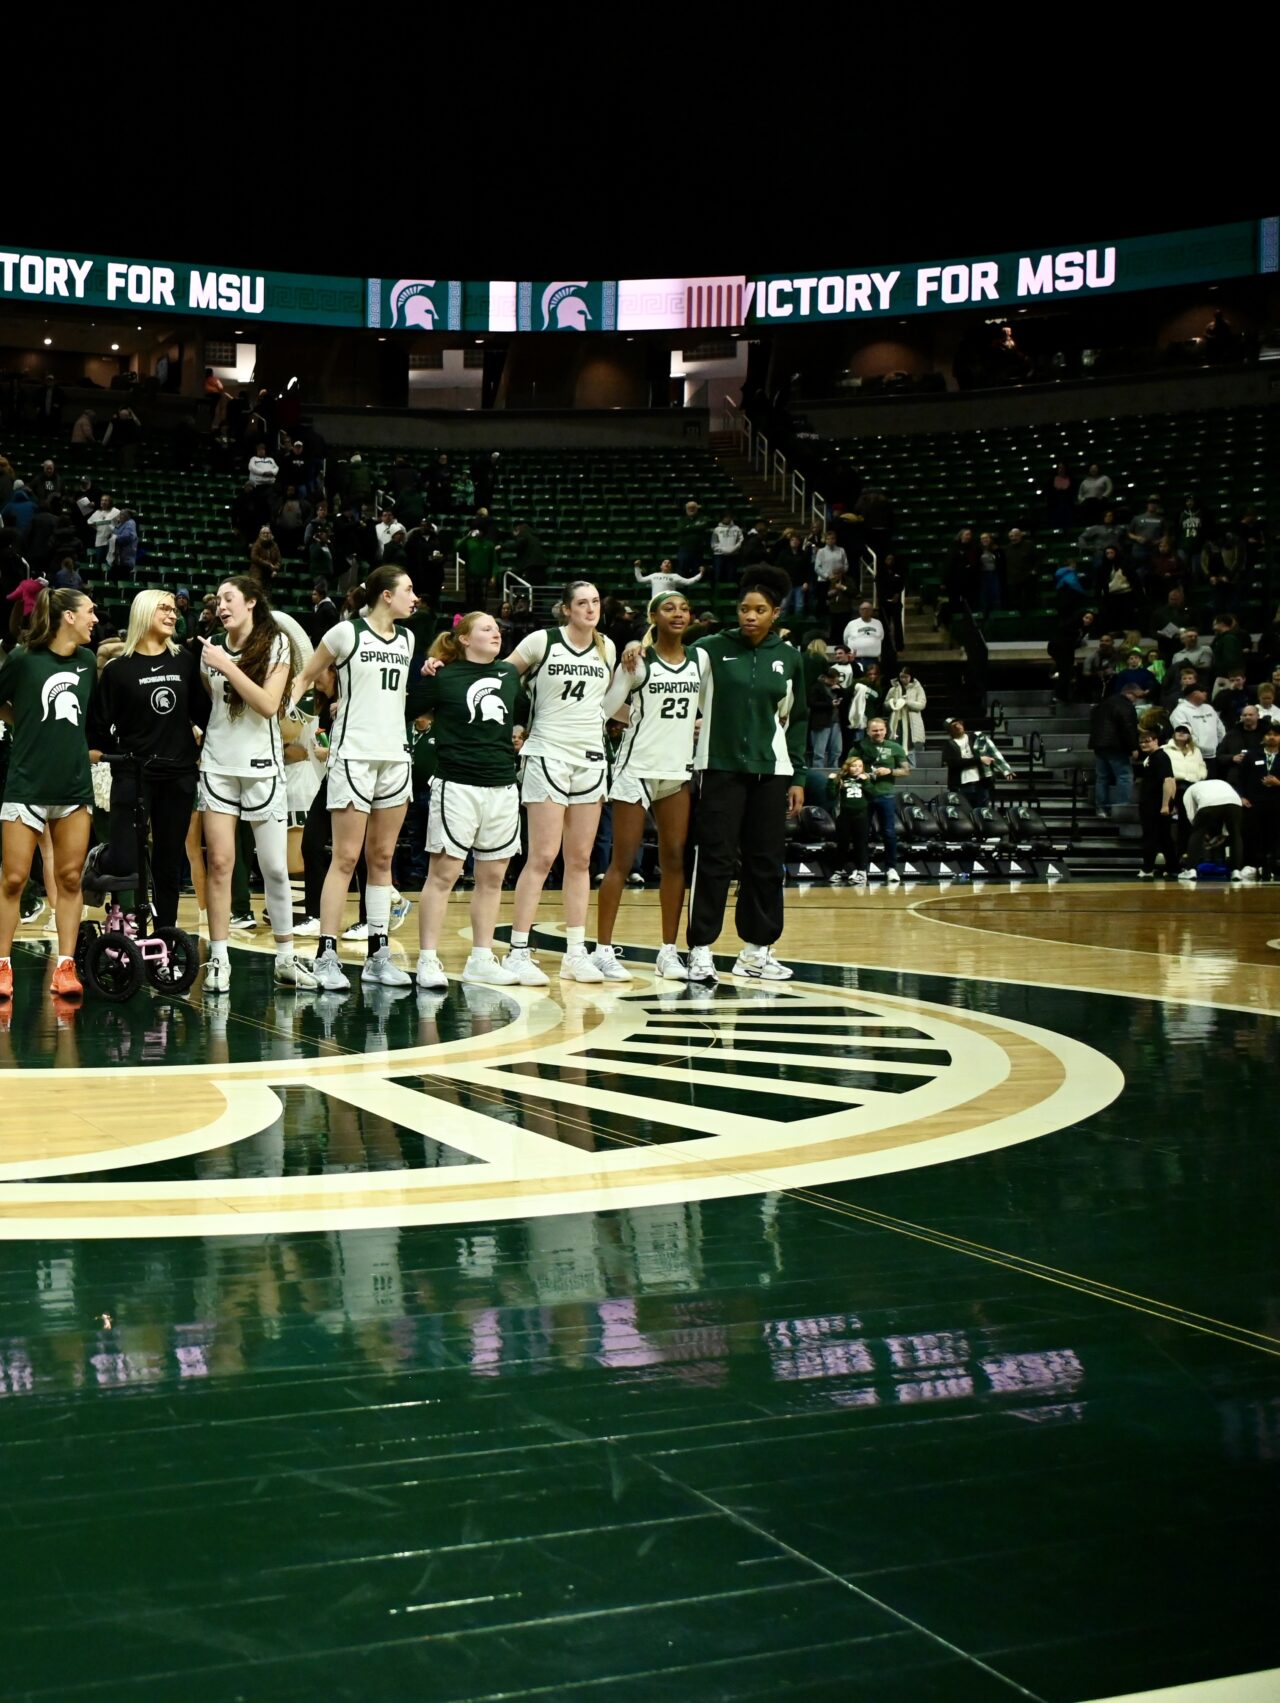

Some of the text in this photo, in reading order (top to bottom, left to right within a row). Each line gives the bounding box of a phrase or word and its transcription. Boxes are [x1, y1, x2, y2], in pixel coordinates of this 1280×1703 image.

[917, 262, 998, 306] FOR
[1017, 247, 1115, 297] MSU
[107, 263, 175, 306] FOR
[189, 270, 265, 314] MSU
[360, 651, 410, 666] SPARTANS
[138, 675, 166, 686] MICHIGAN
[380, 668, 400, 691] 10
[548, 663, 604, 678] SPARTANS
[561, 680, 586, 701] 14
[648, 681, 700, 695] SPARTANS
[661, 698, 689, 719] 23
